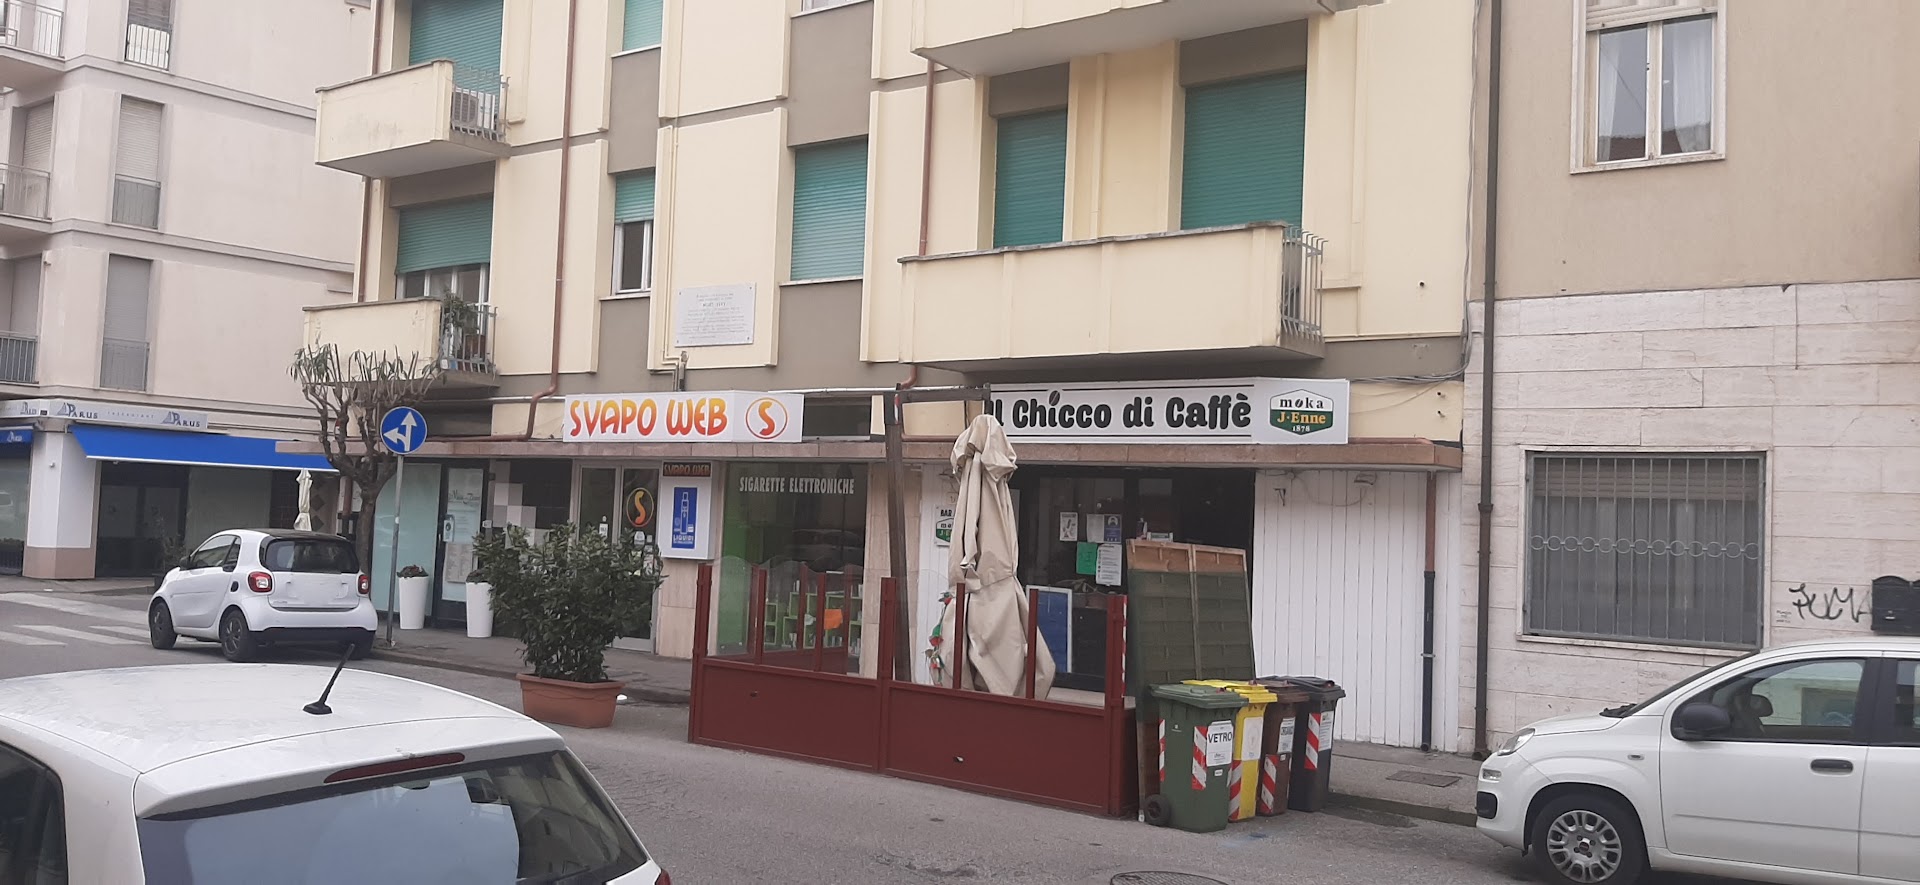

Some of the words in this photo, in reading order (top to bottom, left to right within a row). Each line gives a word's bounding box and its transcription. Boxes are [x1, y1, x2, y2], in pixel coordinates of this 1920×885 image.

[1012, 391, 1112, 429] Chicco
[1122, 396, 1154, 428] di
[1165, 392, 1252, 430] Caffè
[1280, 397, 1324, 409] moka
[569, 398, 657, 437] SVAPO
[666, 397, 728, 436] WEB
[758, 400, 776, 436] S
[739, 476, 785, 492] SIGARETTE
[789, 477, 855, 495] ELETTRONICHE
[1208, 731, 1233, 744] VETRO
